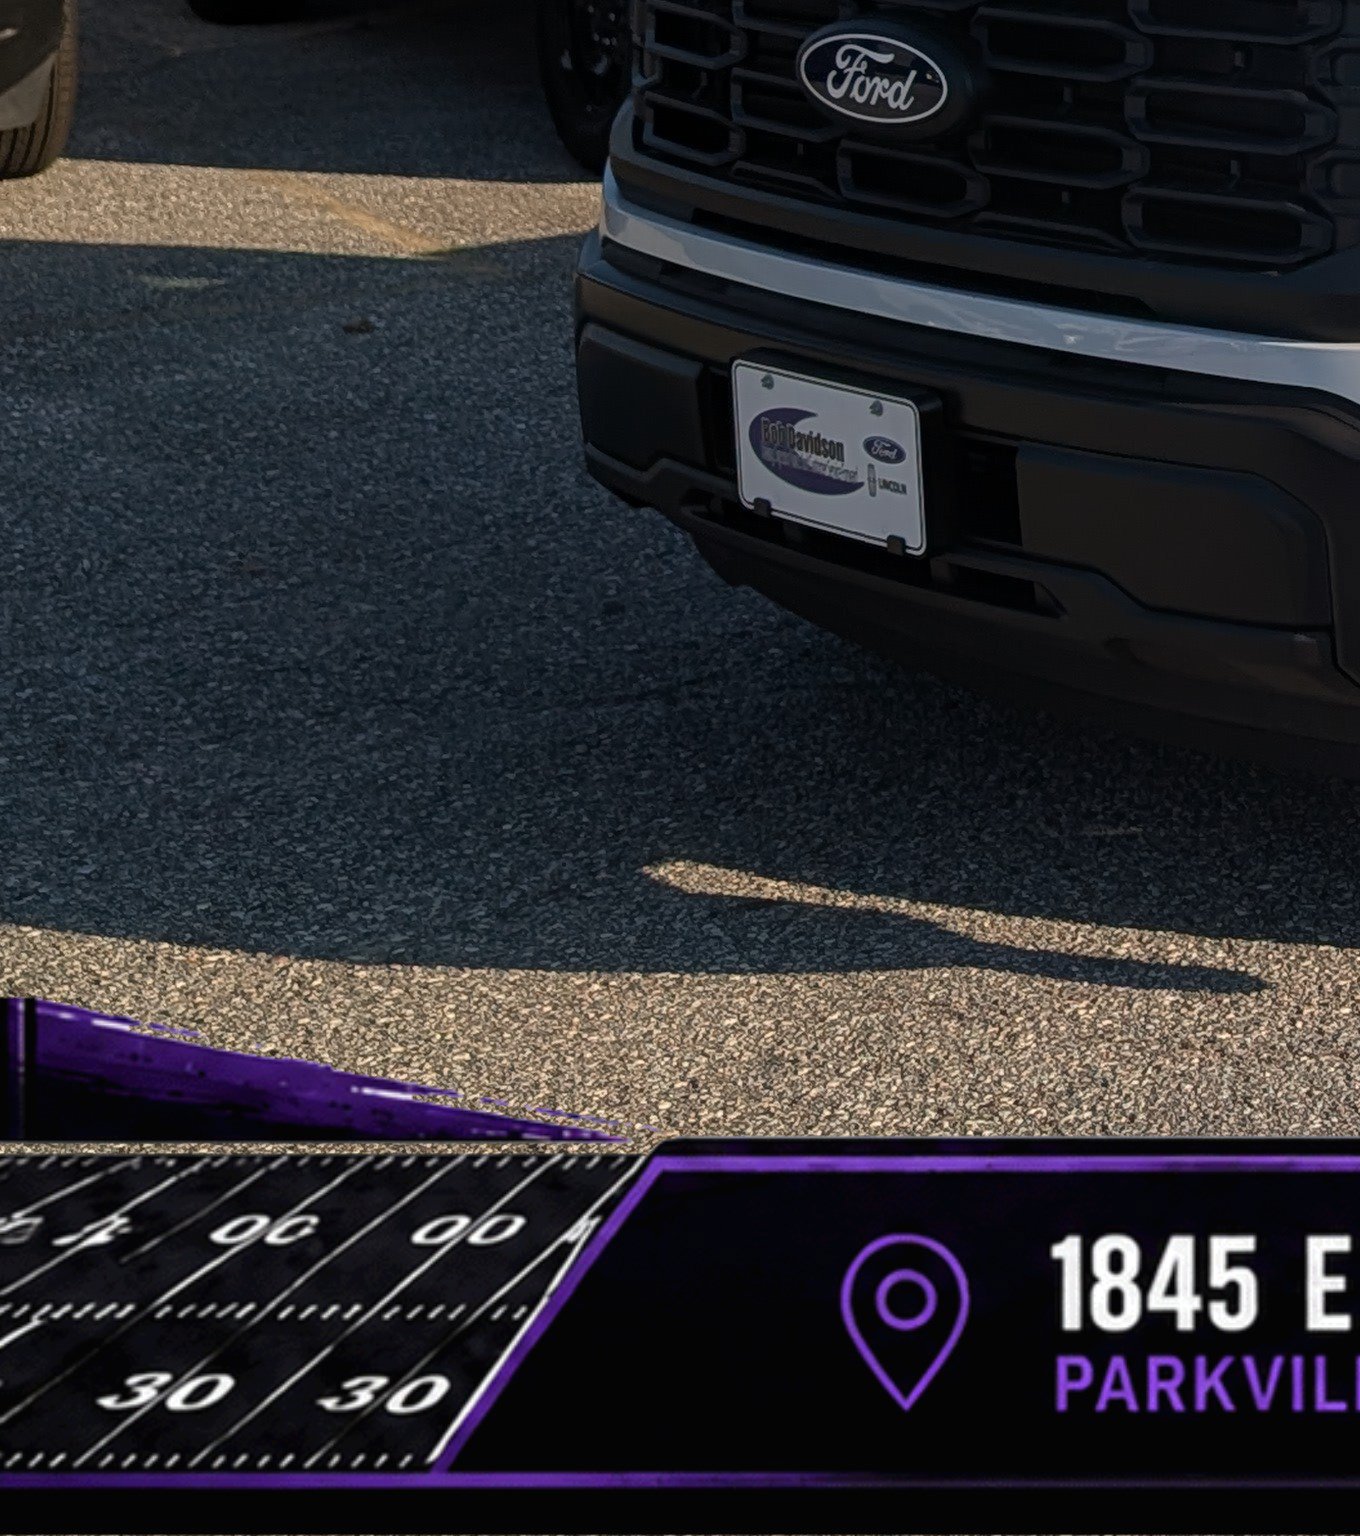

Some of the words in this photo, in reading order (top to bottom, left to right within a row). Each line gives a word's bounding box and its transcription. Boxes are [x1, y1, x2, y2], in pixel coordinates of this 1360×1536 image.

[826, 43, 917, 111] Ford
[761, 417, 789, 448] Bob
[790, 422, 845, 463] Davidson
[870, 438, 898, 460] Ford
